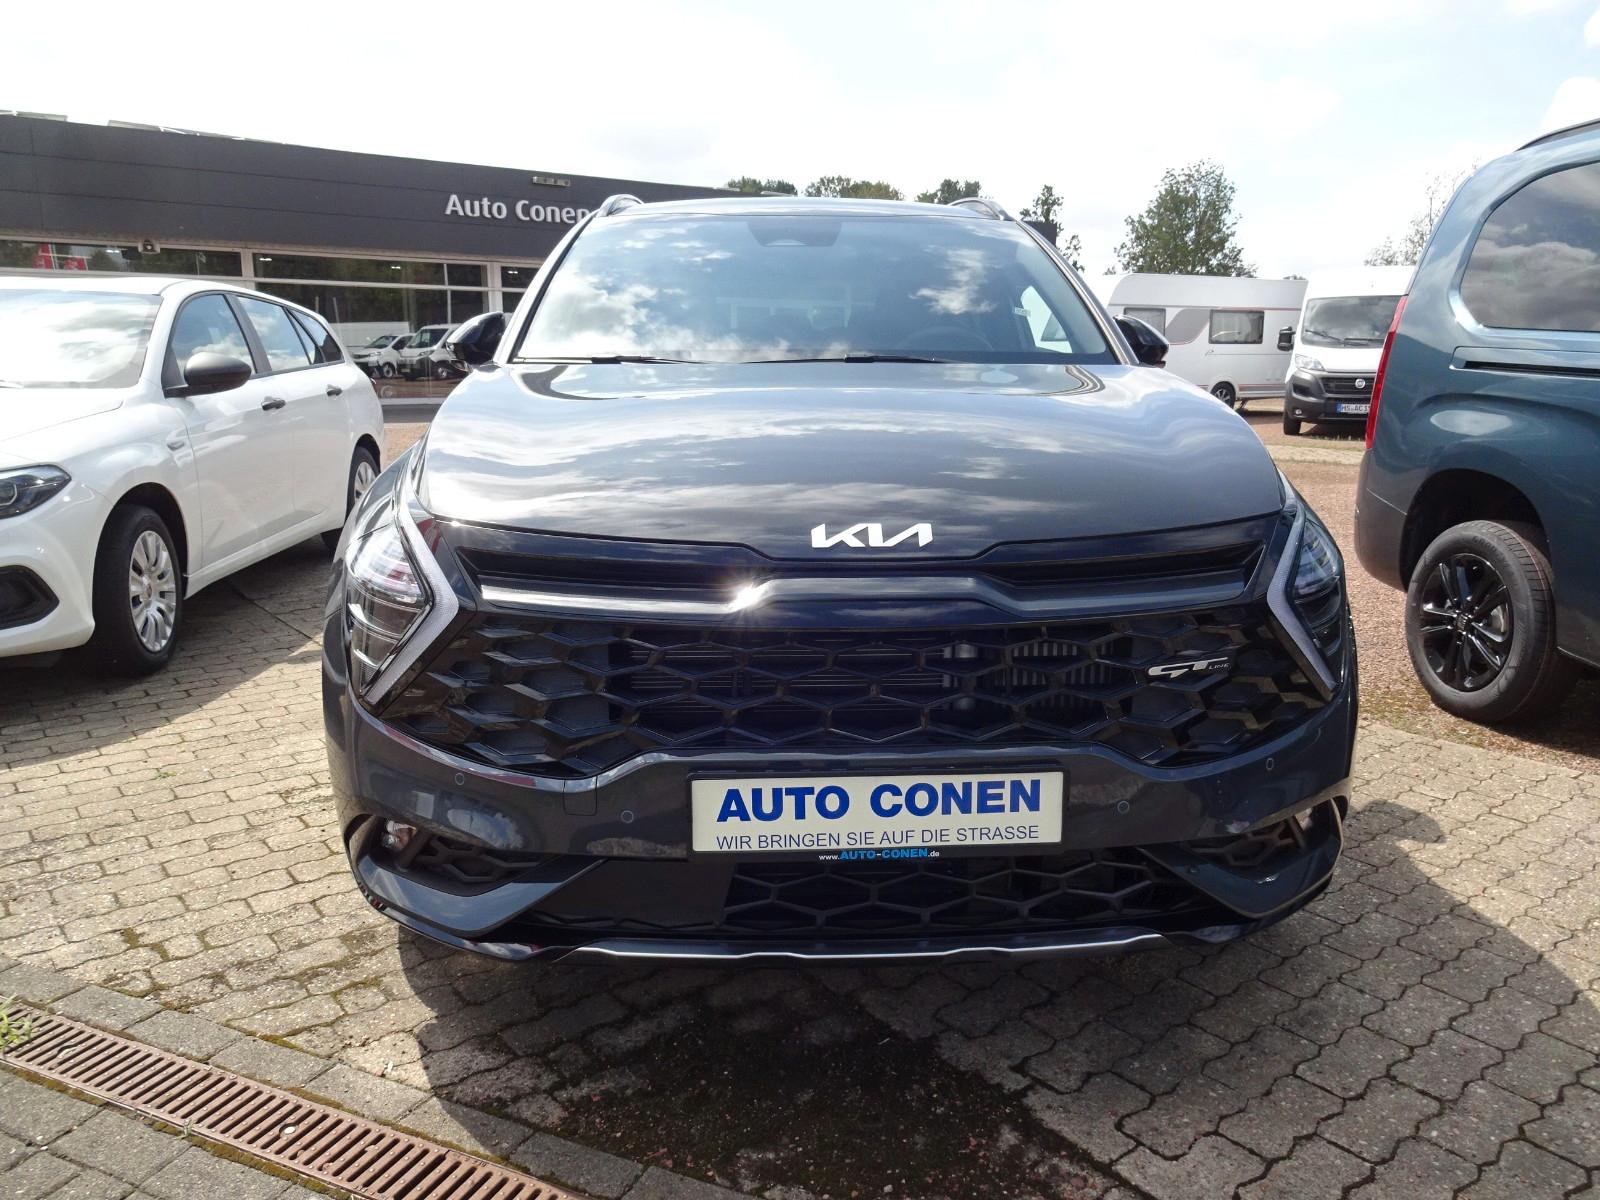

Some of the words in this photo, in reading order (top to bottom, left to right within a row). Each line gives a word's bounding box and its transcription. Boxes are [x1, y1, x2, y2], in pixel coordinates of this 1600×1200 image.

[445, 194, 507, 219] Auto
[811, 523, 933, 548] KIA
[1148, 657, 1228, 678] GT
[716, 785, 850, 822] AUTO
[870, 779, 1041, 818] CONEN
[716, 835, 752, 849] WIR
[758, 832, 840, 849] BRINGEN
[846, 831, 875, 846] SIE
[879, 829, 916, 844] AUF
[921, 828, 950, 843] DIE
[956, 825, 1039, 841] STRASSE
[818, 848, 940, 860] www.AUTO-CONEN.de
